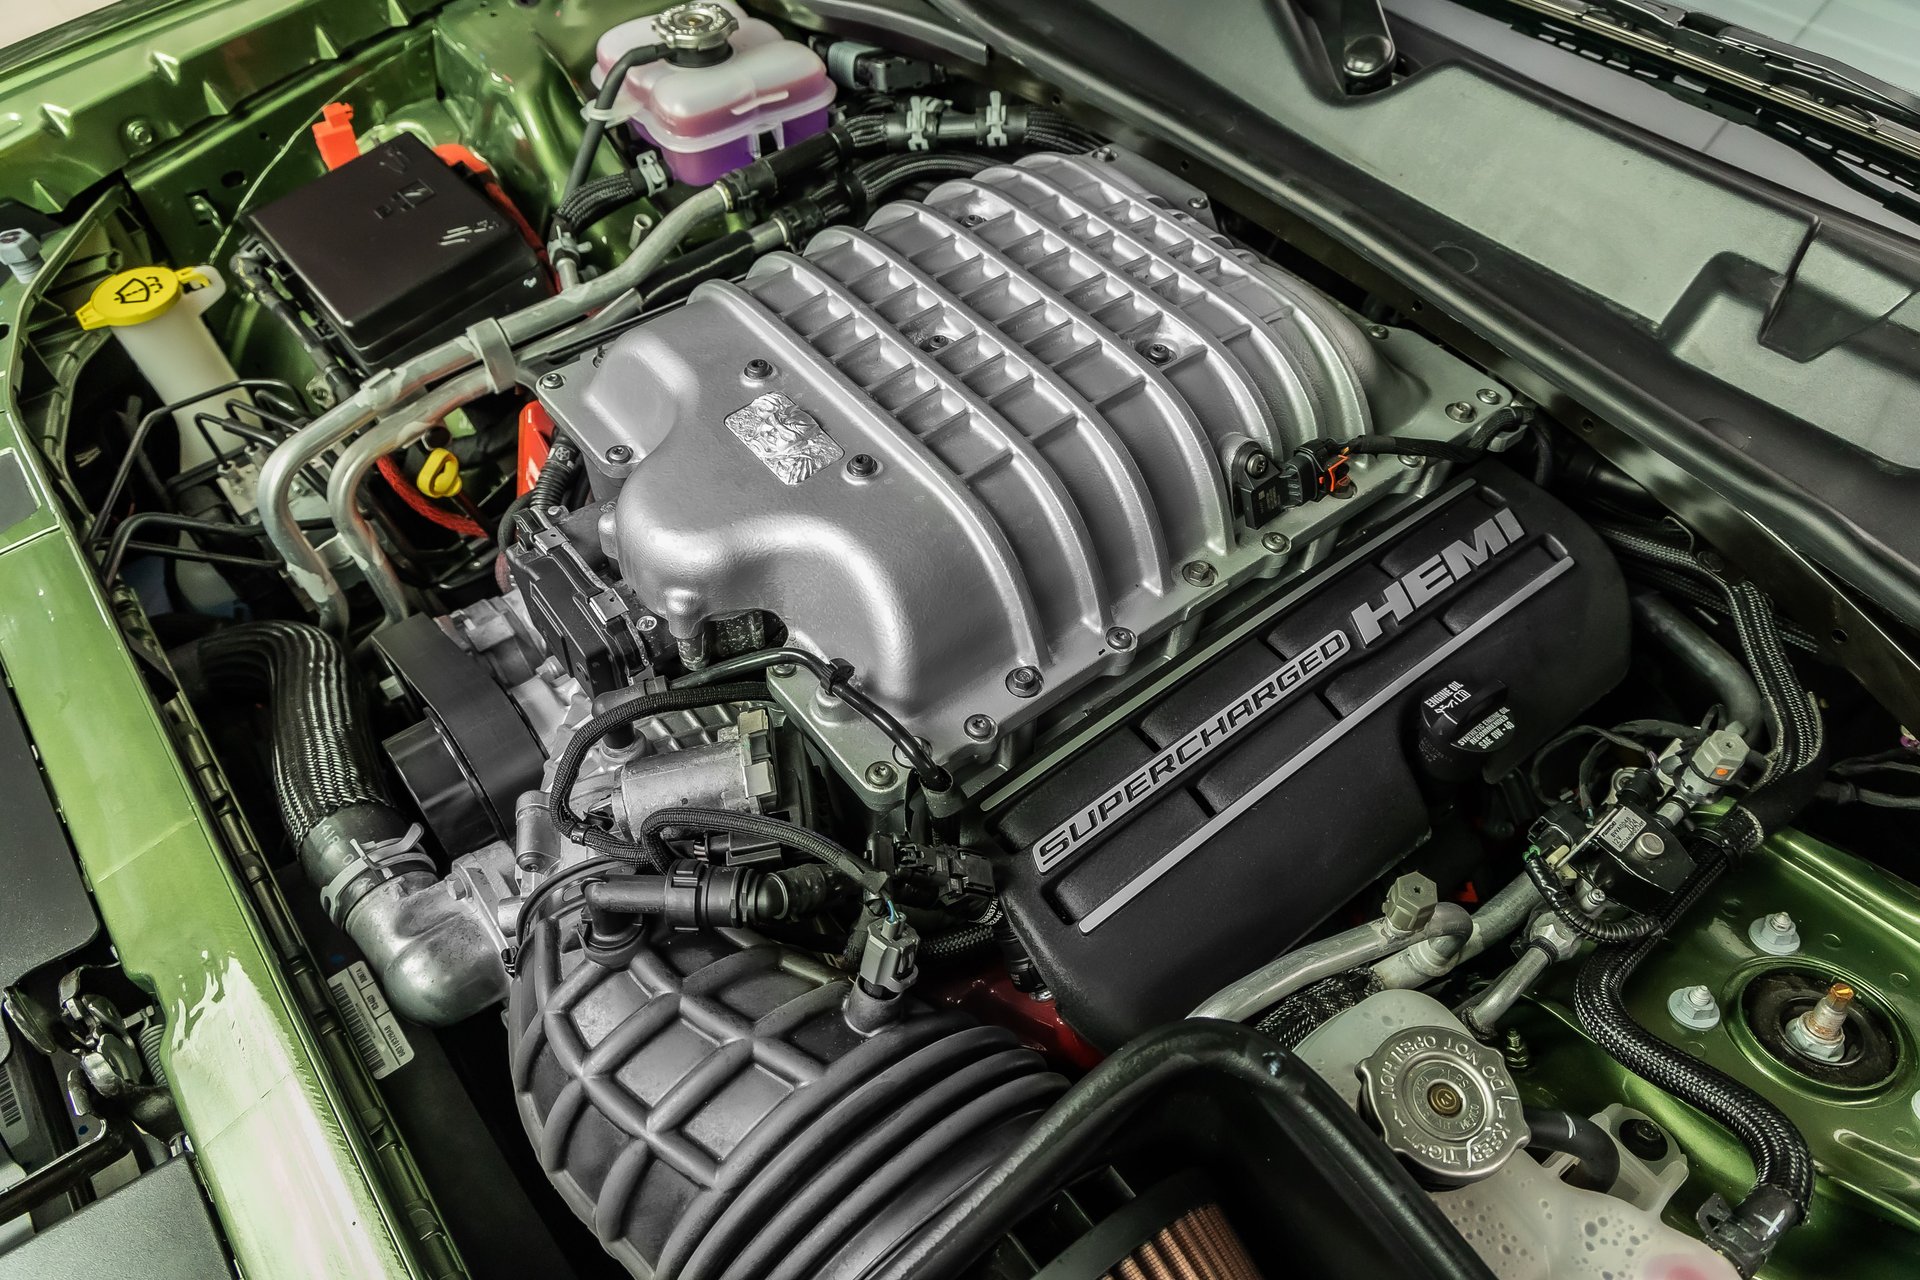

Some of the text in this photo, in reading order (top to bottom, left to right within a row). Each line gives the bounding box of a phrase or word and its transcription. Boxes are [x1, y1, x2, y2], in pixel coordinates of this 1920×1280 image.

[1039, 507, 1525, 862] SUPERCHARGED HEMI
[1424, 681, 1464, 708] ENGINE OIL
[1458, 706, 1510, 746] SYNTHETIC ENGINE OIL
[1469, 715, 1509, 745] RECOMMENDED
[1478, 736, 1494, 749] SAE
[1391, 1035, 1436, 1064] OPEN
[1444, 1037, 1479, 1067] NOT
[1380, 1060, 1402, 1099] HOT
[1482, 1065, 1506, 1091] DO
[1403, 1122, 1511, 1165] KEEP TIGHT
